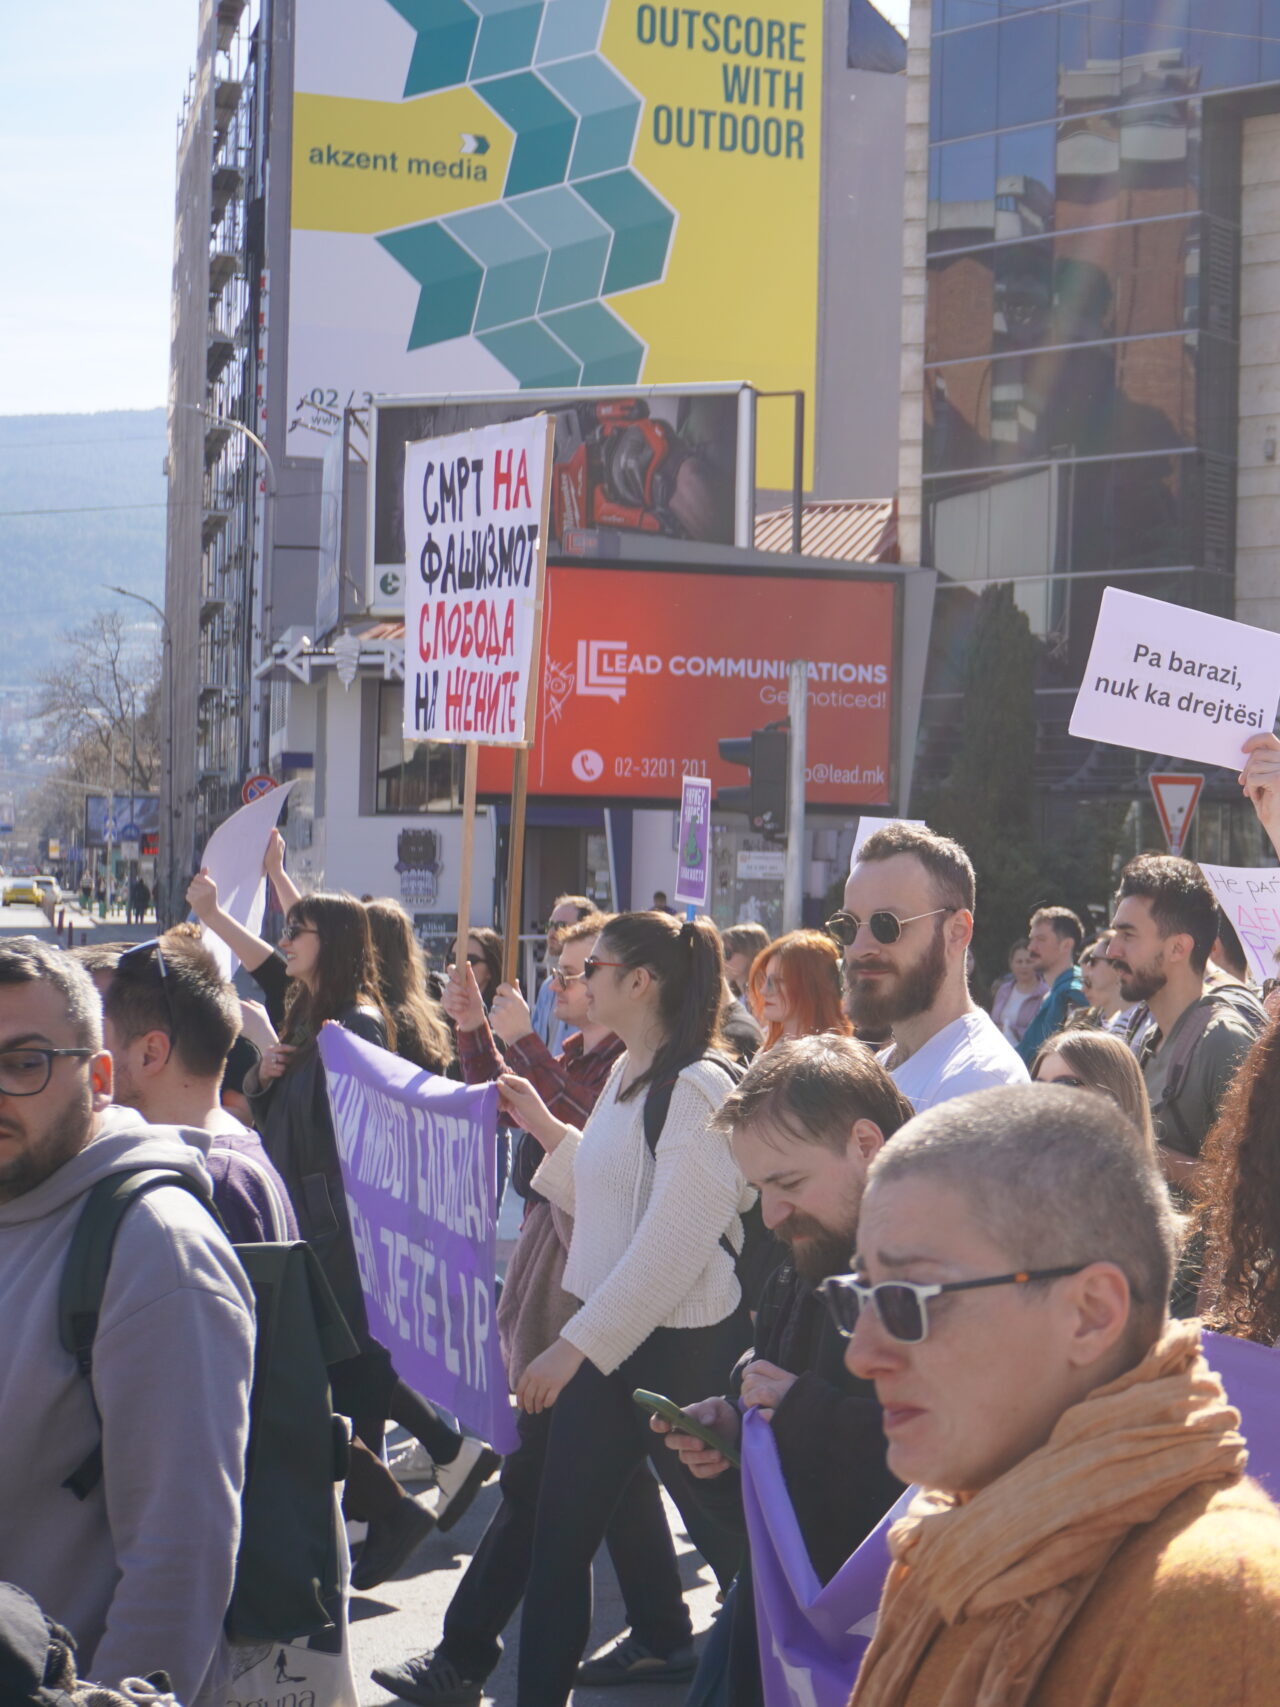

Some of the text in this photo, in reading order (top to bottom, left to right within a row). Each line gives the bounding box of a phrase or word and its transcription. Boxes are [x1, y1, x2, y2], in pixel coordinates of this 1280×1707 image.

[637, 4, 806, 62] OUTSCORE
[722, 63, 803, 111] WITH
[653, 104, 804, 160] OUTDOOR
[308, 144, 488, 182] akzent media
[422, 456, 484, 526] СМРТ
[493, 448, 531, 511] НА
[420, 523, 539, 595] ФАШИЗМОТ
[418, 599, 515, 665] СЛОБОДА
[602, 653, 887, 684] LEAD COMMUNIATIONS
[1132, 643, 1242, 692] Pa barazi,
[445, 666, 520, 735] ЖЕНИТЕ
[759, 686, 887, 709] Ge noticed!
[1094, 676, 1264, 729] nuk ka drejtësi
[614, 757, 707, 778] 02-3201 201
[801, 763, 885, 785] o@lead.mk
